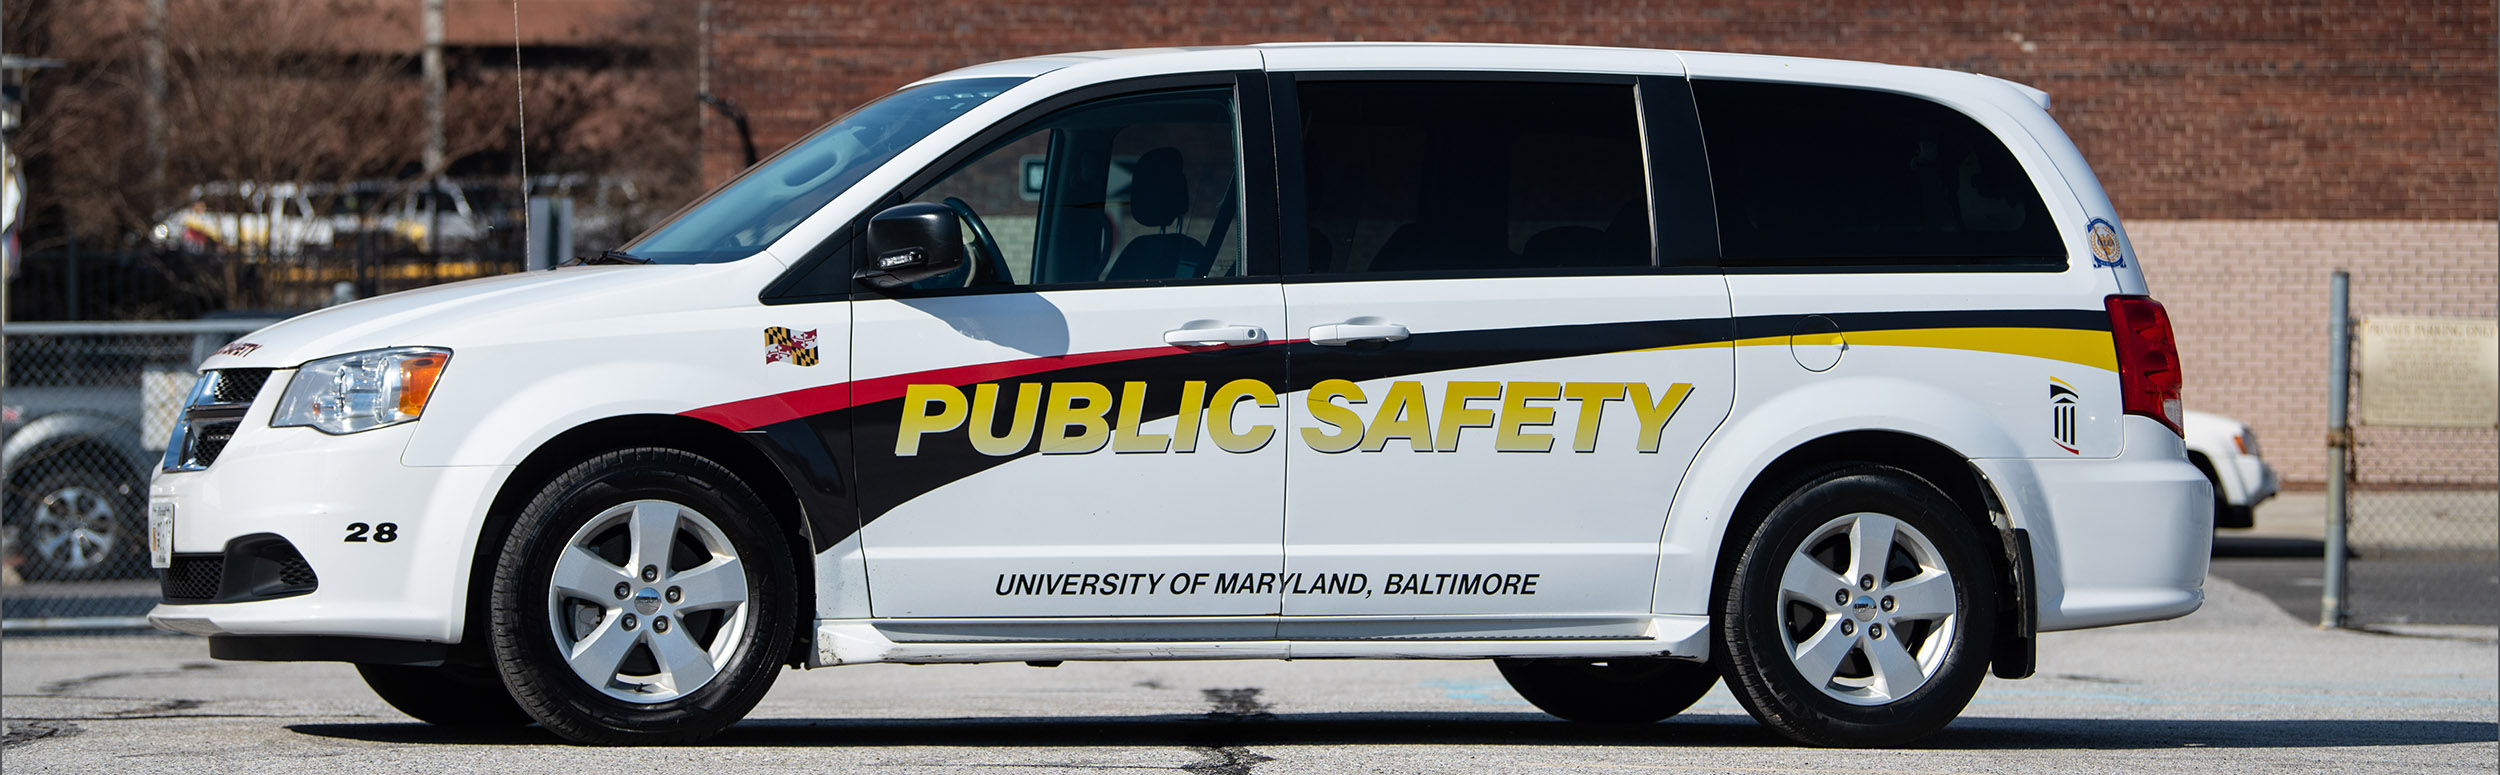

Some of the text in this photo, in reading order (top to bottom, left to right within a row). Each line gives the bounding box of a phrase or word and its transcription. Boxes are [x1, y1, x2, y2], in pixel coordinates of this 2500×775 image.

[2415, 325, 2462, 337] PARKING
[2465, 325, 2496, 337] ONLY
[894, 378, 1696, 457] PUBLIC SAFETY
[344, 521, 398, 543] 28
[995, 572, 1541, 599] UNIVERSITY OF MARYLAND, BALTIMORE
